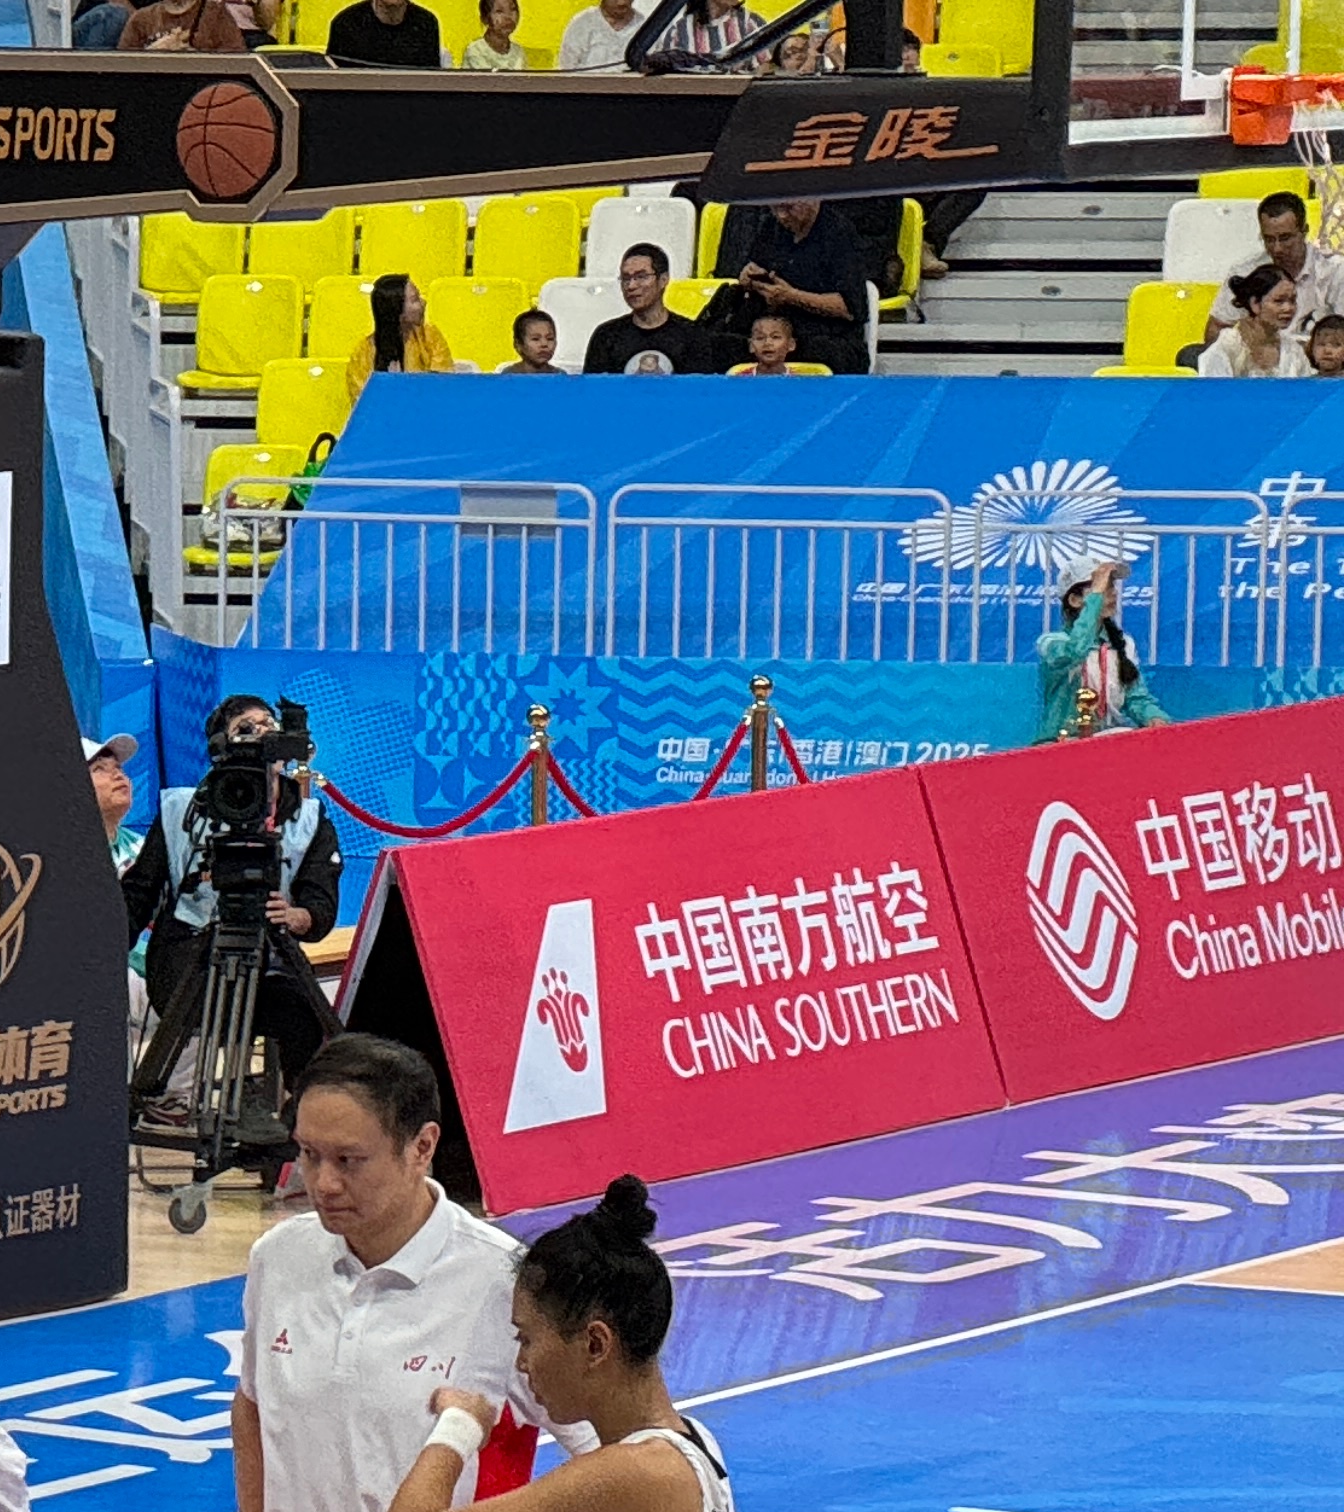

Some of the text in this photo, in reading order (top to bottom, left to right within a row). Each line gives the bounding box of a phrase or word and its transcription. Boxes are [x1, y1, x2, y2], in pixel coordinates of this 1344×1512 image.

[745, 106, 999, 172] 金陵
[1135, 772, 1343, 901] 中国移动
[634, 859, 939, 1003] 中国南方航空
[1166, 887, 1344, 981] China Mobil
[662, 969, 960, 1078] CHINA SOUTHERN
